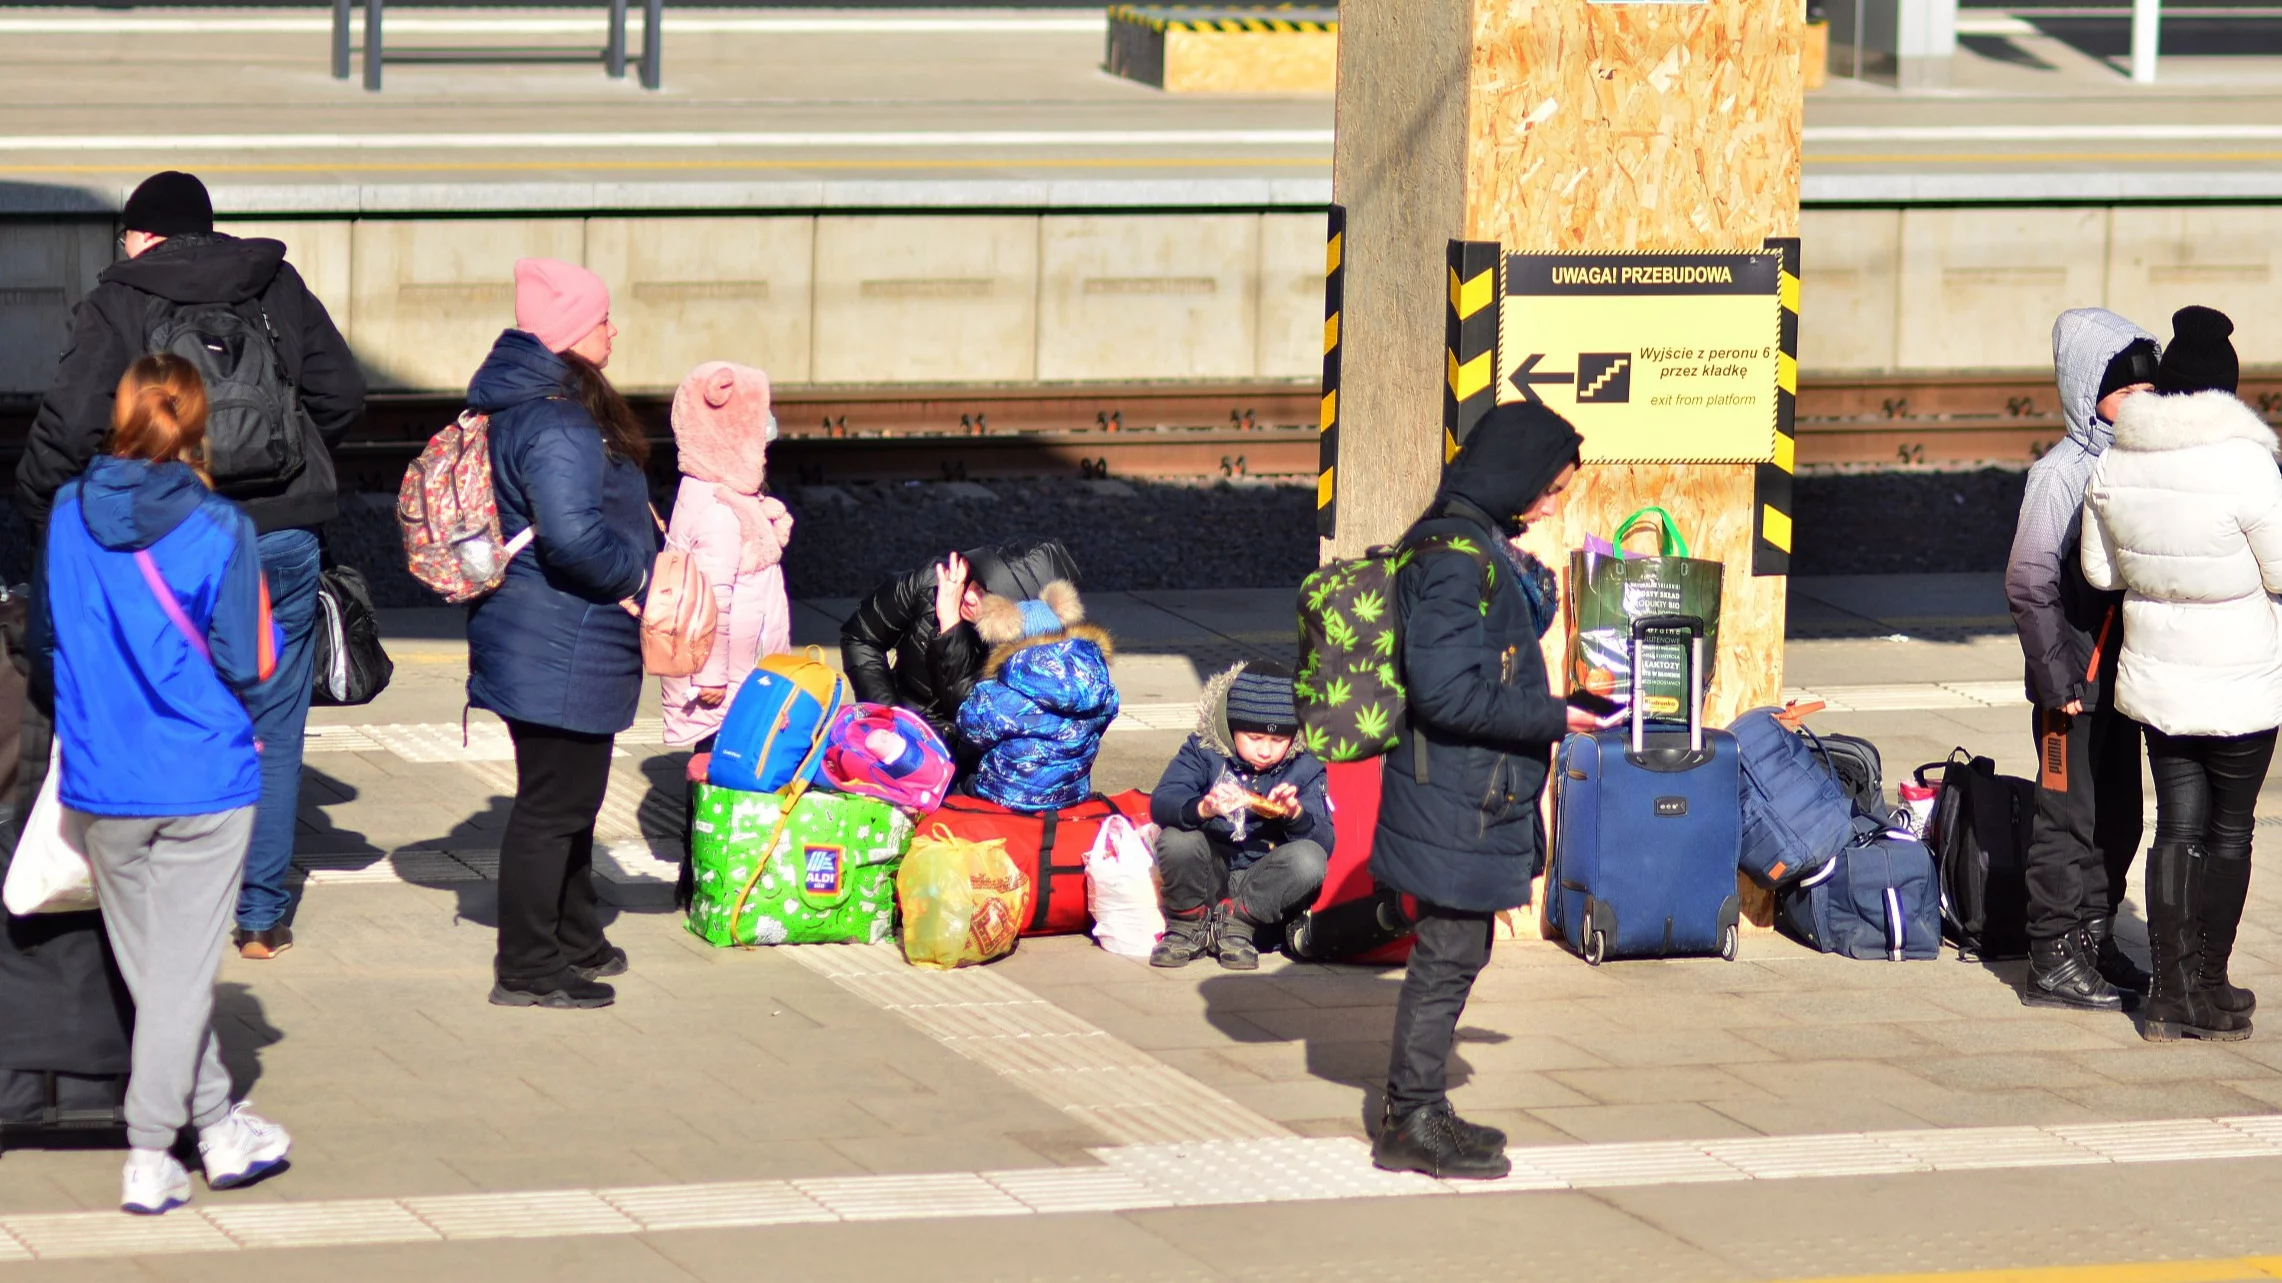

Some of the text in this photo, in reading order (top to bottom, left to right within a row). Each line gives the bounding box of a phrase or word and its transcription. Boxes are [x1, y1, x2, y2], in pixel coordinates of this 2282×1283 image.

[1552, 266, 1733, 284] UWAGA! PRZEBUDOWA
[1640, 346, 1771, 362] Wyjście z peronu 6
[1660, 364, 1748, 380] przez kładkę
[1650, 393, 1756, 408] exit from platform
[2048, 737, 2062, 774] PUMA
[806, 872, 835, 883] ALDI
